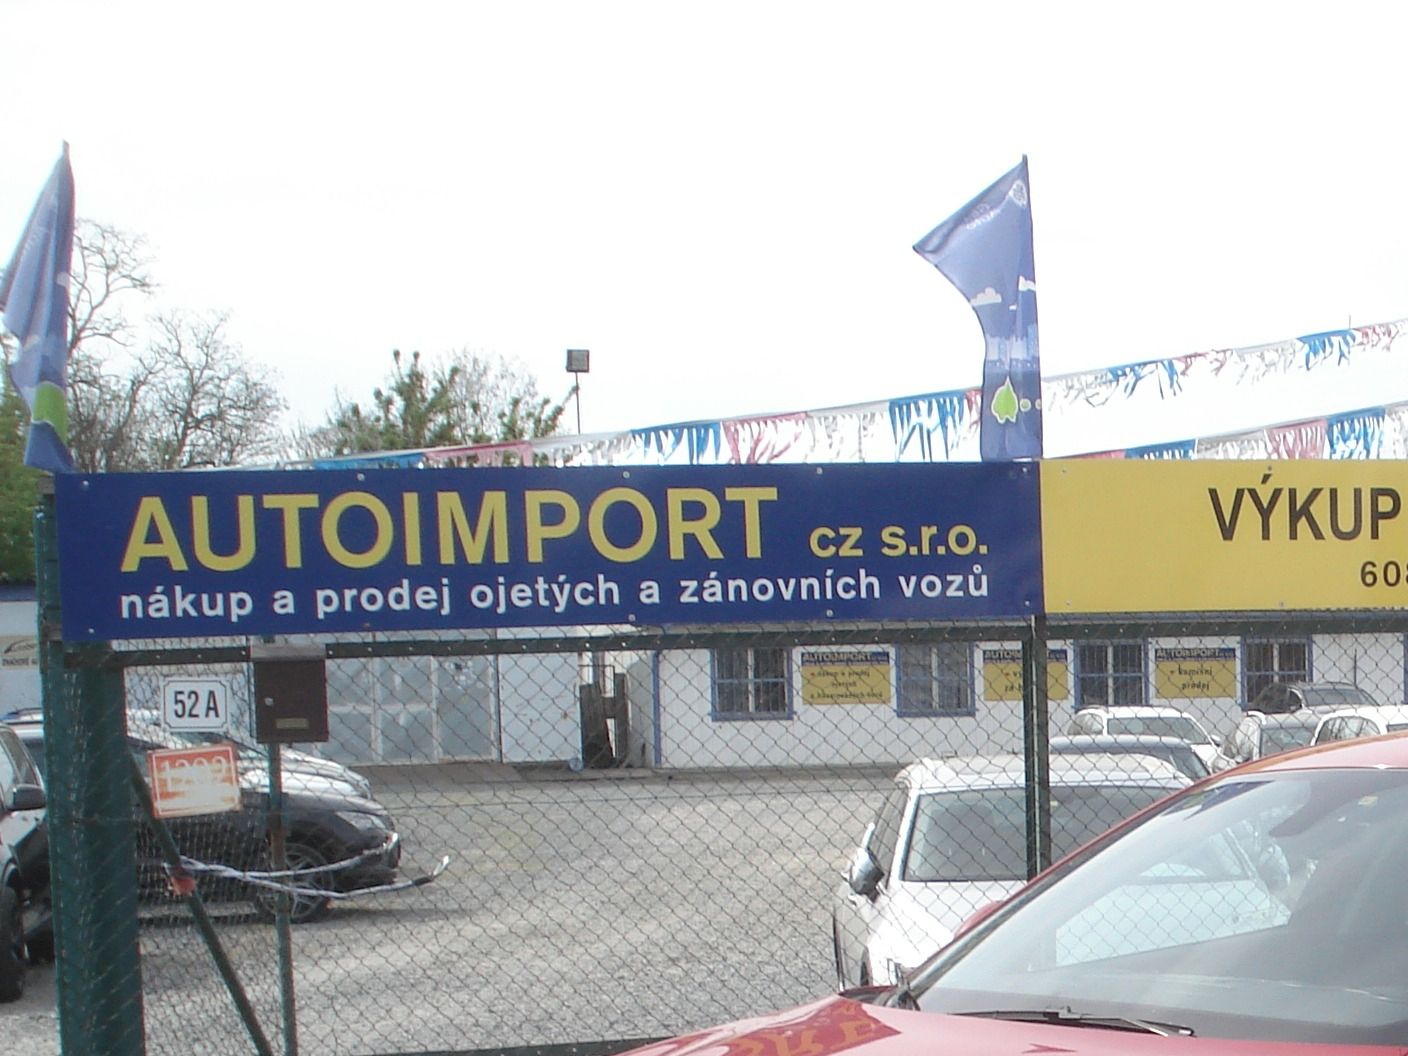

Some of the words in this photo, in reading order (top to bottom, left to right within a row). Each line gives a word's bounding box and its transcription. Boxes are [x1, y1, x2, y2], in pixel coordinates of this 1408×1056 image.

[120, 485, 779, 573] AUTOIMPORT
[809, 524, 864, 558] cz
[881, 521, 989, 557] s.r.o.
[1208, 473, 1402, 542] VÝKUP
[119, 585, 254, 623] nákup
[273, 588, 296, 615] a
[317, 578, 451, 618] prodej
[470, 574, 620, 614] ojetých
[639, 580, 661, 604] a
[679, 568, 882, 605] zánovních
[898, 564, 989, 599] vozů
[174, 690, 199, 718] 52
[205, 690, 220, 718] A
